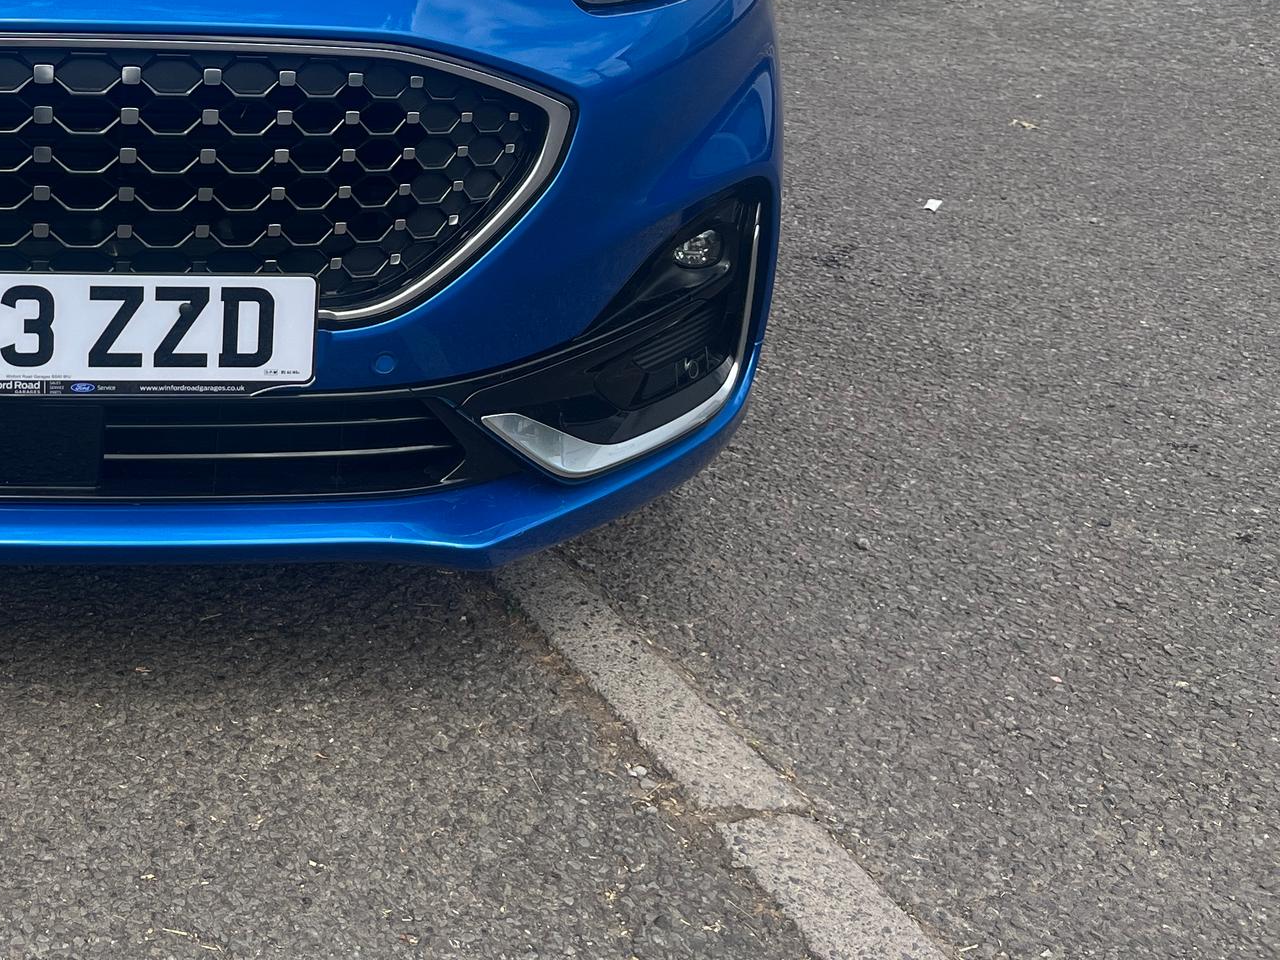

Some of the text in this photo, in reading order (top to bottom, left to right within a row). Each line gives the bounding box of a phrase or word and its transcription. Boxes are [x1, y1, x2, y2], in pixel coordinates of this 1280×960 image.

[87, 285, 275, 368] ZZD
[14, 381, 40, 390] Road
[139, 384, 246, 392] www.winfordroadgarages.co.uk
